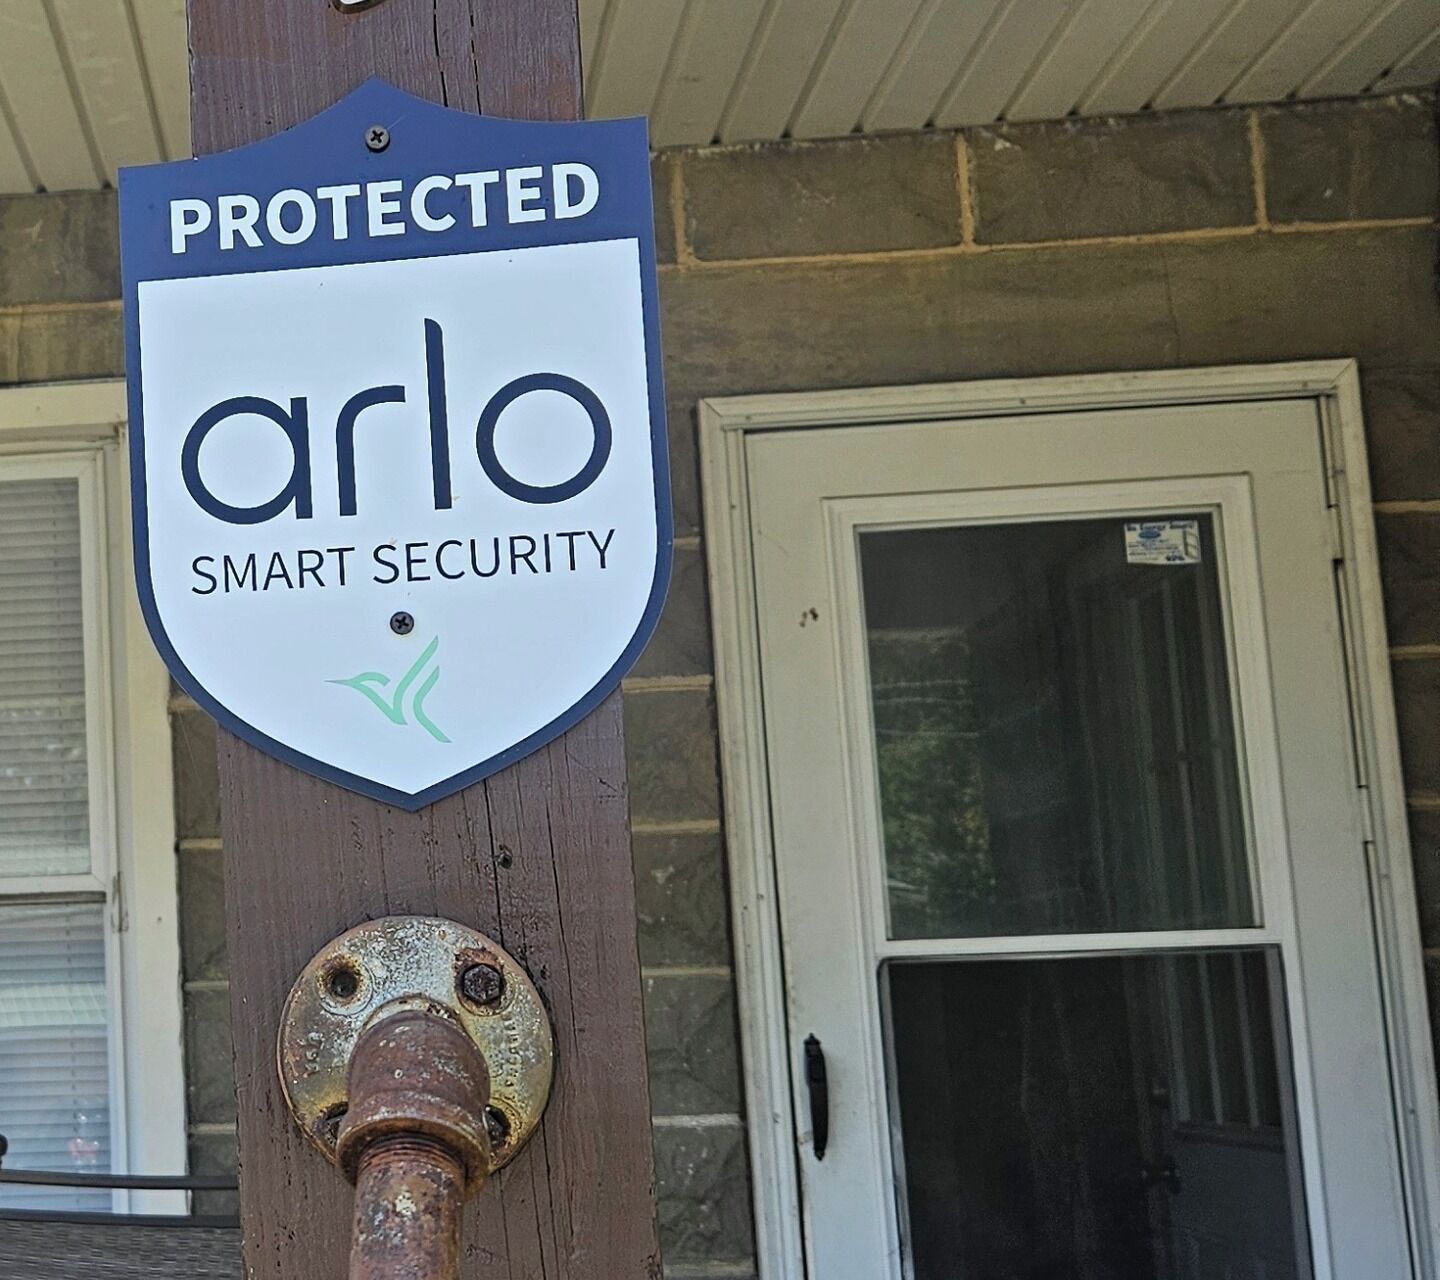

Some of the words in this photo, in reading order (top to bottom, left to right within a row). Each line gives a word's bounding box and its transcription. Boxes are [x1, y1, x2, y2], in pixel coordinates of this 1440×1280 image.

[169, 161, 600, 255] PROTECTED
[180, 317, 613, 526] arlo
[190, 546, 356, 596] SMART
[371, 528, 616, 585] SECURITY
